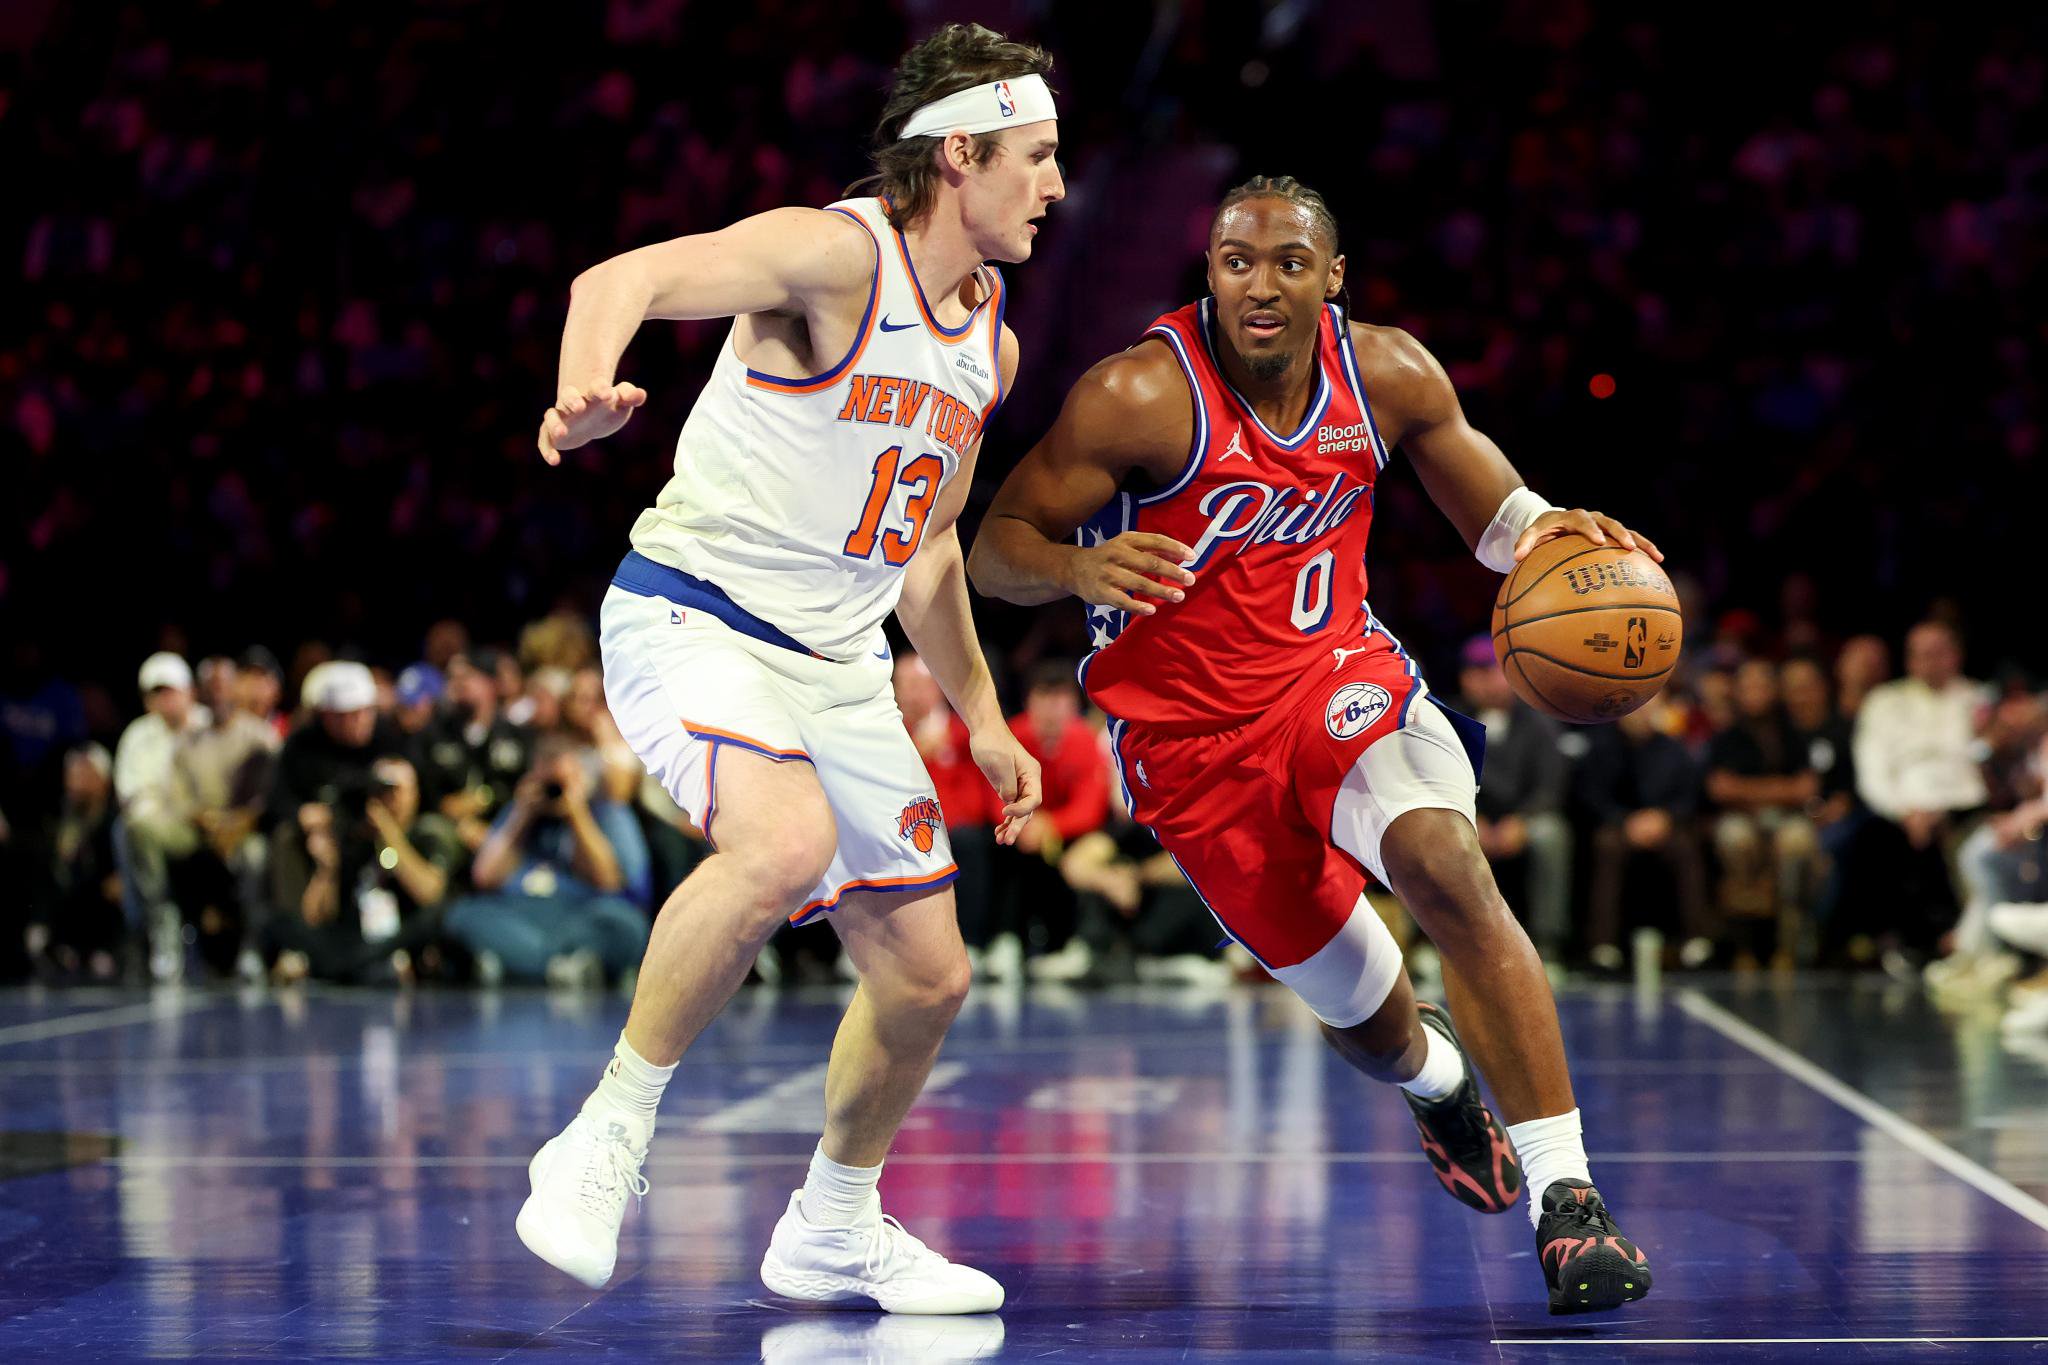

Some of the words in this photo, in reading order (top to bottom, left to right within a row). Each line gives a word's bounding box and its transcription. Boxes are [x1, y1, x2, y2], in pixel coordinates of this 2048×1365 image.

[837, 374, 931, 428] NEW
[925, 386, 981, 457] YORK
[1317, 436, 1368, 454] energy
[1318, 422, 1368, 442] Bloom
[843, 445, 945, 568] 13
[1178, 471, 1370, 572] Phila
[1290, 548, 1336, 635] 0
[898, 797, 942, 837] KNICKS
